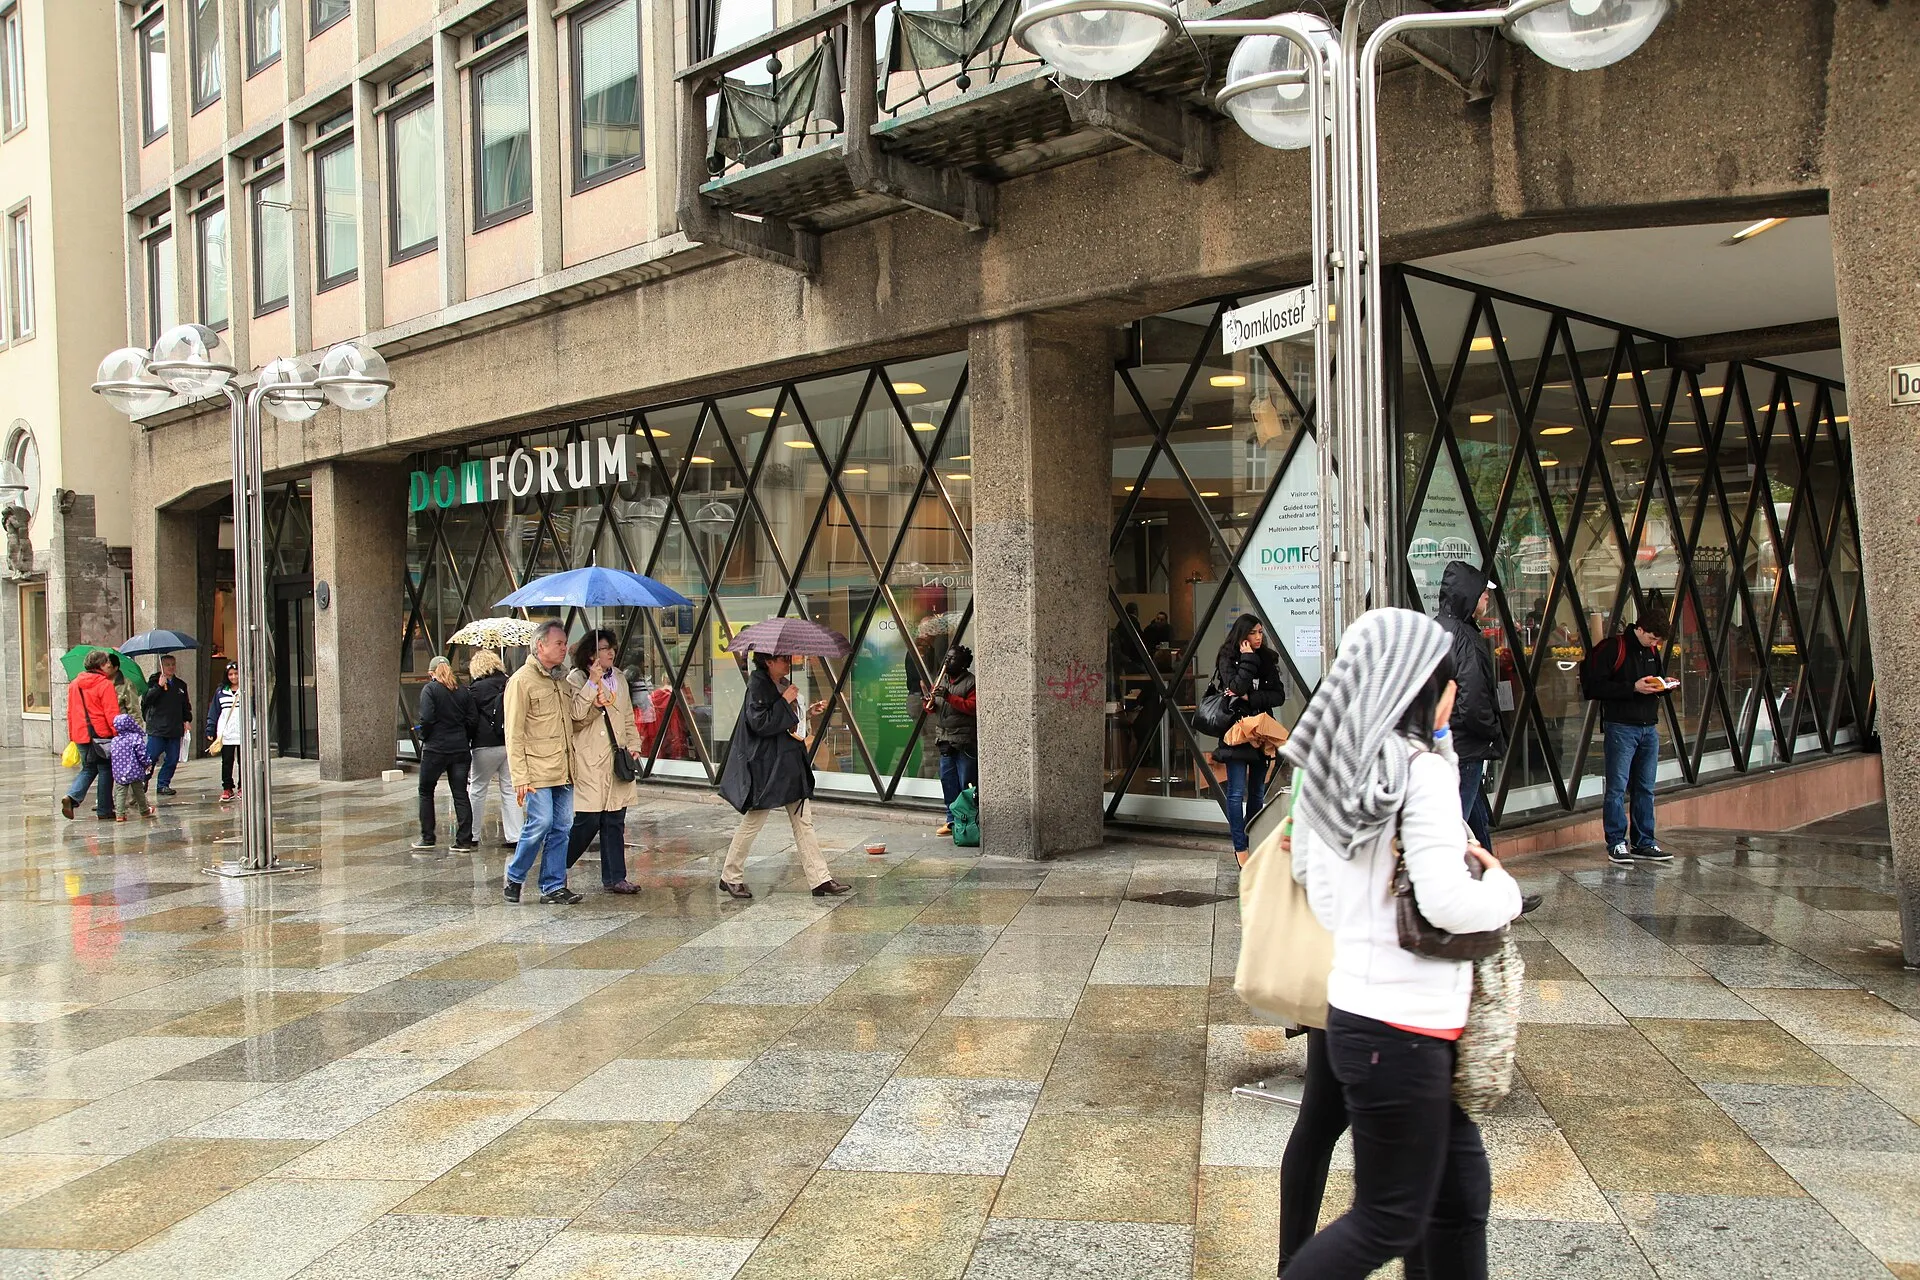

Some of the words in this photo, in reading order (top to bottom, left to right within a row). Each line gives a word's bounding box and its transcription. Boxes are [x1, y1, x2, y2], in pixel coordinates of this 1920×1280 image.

[1234, 304, 1306, 341] Domkloster
[1283, 504, 1303, 512] Guided
[1279, 512, 1304, 520] cathedral
